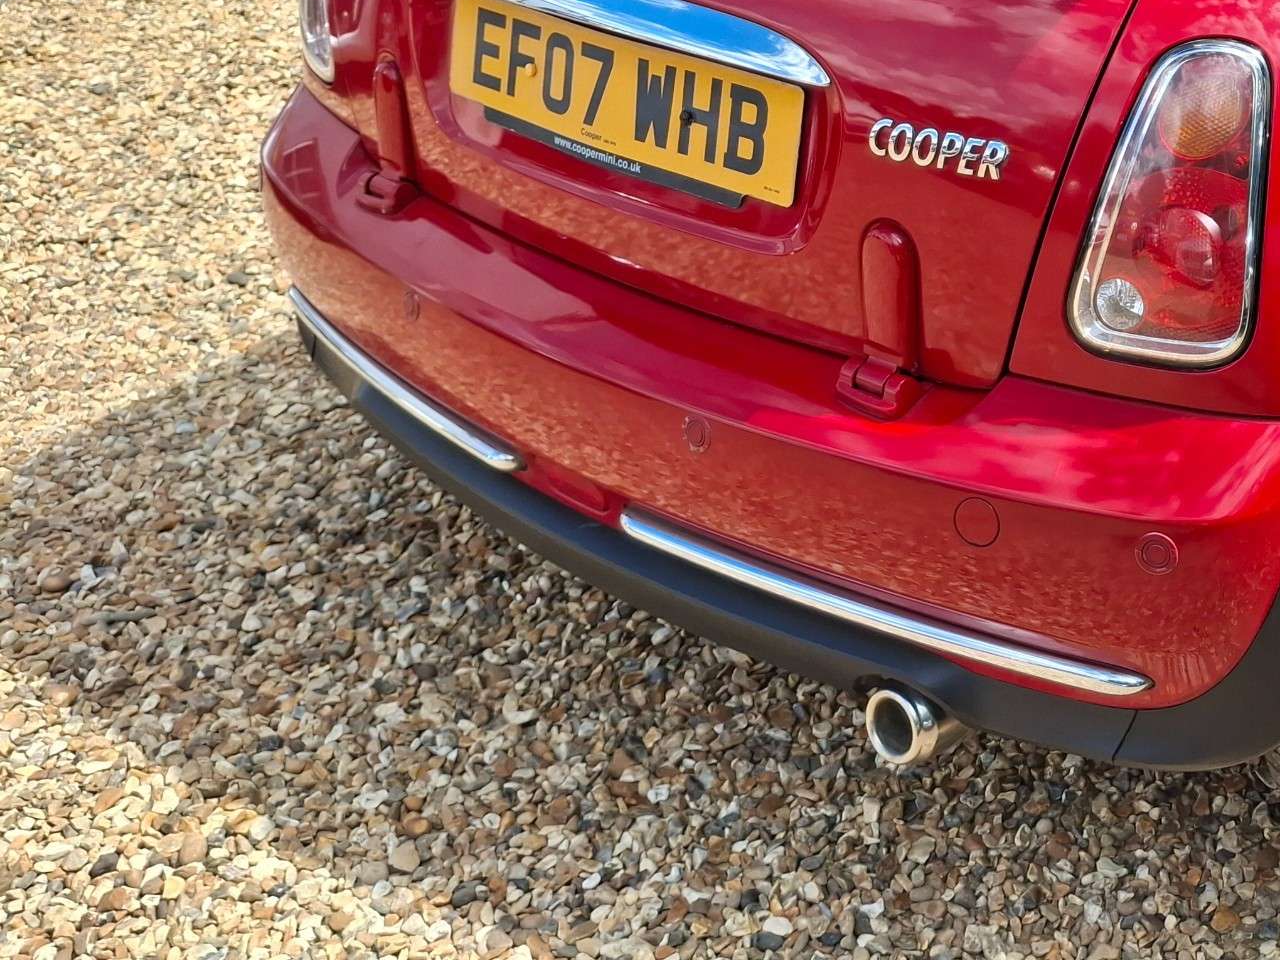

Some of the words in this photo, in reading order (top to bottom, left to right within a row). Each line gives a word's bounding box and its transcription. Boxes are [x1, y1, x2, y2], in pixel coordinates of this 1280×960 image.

[472, 6, 616, 127] EF07
[634, 57, 769, 176] WHB
[553, 135, 641, 174] www.coopermini.co.uk
[868, 118, 1009, 181] COOPER
